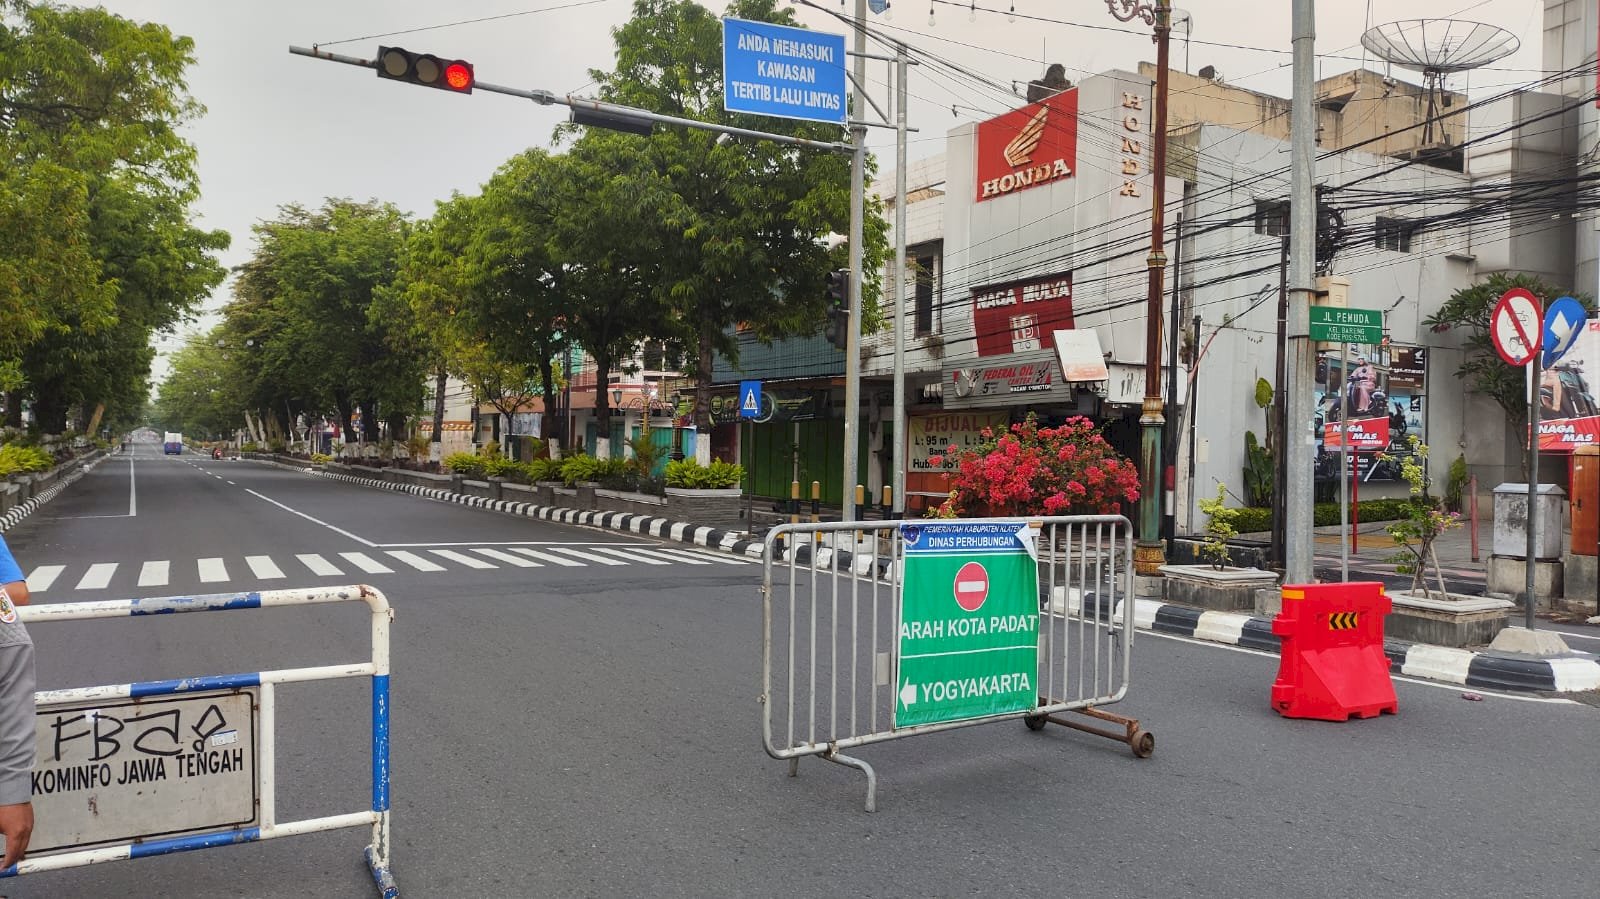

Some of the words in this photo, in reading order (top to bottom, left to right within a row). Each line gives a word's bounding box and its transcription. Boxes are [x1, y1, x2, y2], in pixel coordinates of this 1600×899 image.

[737, 33, 770, 53] ANDA
[773, 38, 833, 63] MEMASUKI
[757, 60, 816, 84] KAWASAN
[732, 80, 771, 101] TERTIB
[773, 86, 802, 105] LALU
[804, 90, 840, 110] LINTAS
[1120, 91, 1144, 198] HONDA
[981, 158, 1072, 199] HONDA
[977, 288, 1017, 310] NAGA
[1022, 280, 1070, 303] MULYA
[1336, 312, 1370, 324] PEMUDA
[1341, 327, 1365, 335] BARENG
[982, 367, 1017, 381] FEDERAL
[1019, 364, 1034, 377] OIL
[924, 415, 982, 433] DIJUAL
[1332, 424, 1363, 433] NGA
[1538, 424, 1575, 434] NAGA
[926, 436, 937, 446] 95
[1352, 432, 1377, 440] MAS
[1561, 433, 1593, 443] MAS
[923, 525, 964, 534] PEMERINTAH
[964, 525, 999, 533] KABUPATEN
[928, 537, 954, 547] DINAS
[956, 536, 1015, 547] PERHUBUNGAN
[900, 620, 944, 640] ARAH
[947, 617, 987, 637] KOTA
[989, 614, 1038, 634] PADAT
[921, 672, 1031, 703] YOGYAKARTA
[117, 756, 167, 785] JAWA
[175, 747, 244, 777] TENGAH
